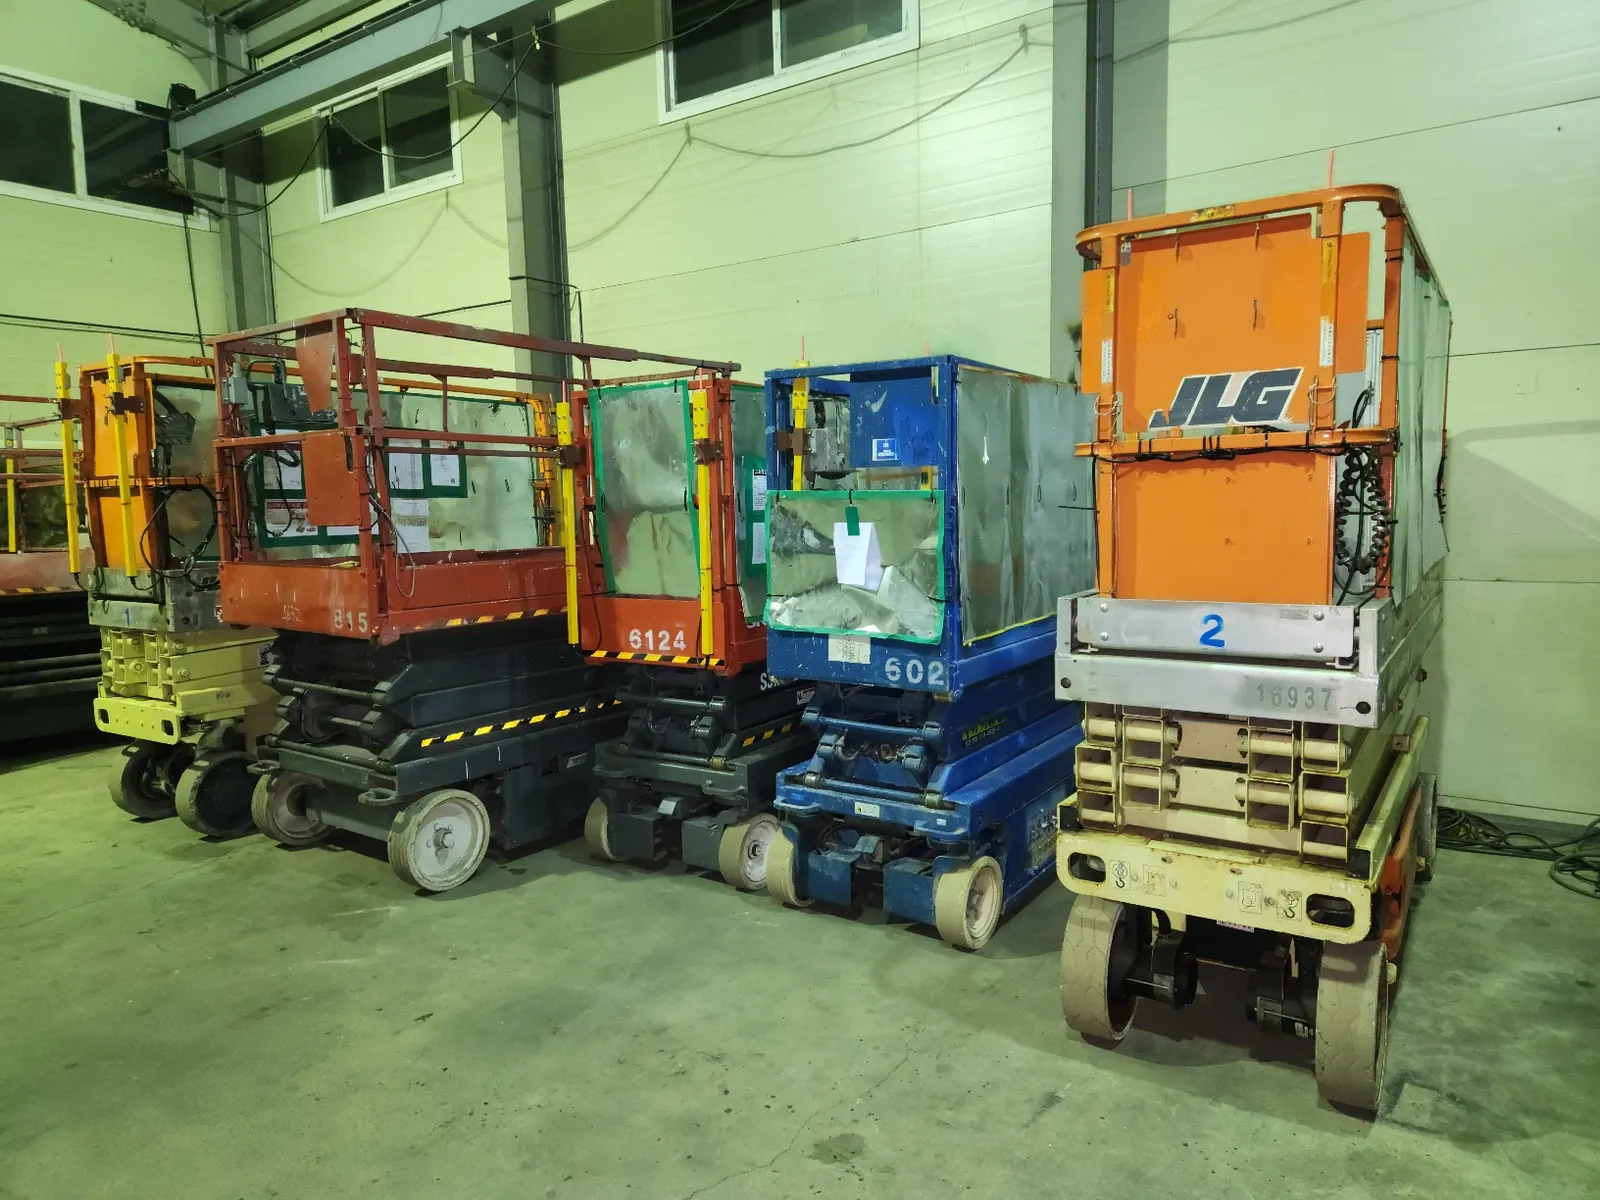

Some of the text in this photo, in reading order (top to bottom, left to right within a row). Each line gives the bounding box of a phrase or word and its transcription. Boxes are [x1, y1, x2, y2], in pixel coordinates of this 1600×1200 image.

[1148, 367, 1303, 429] JLG
[124, 608, 130, 626] 1
[333, 608, 368, 633] 815
[1199, 613, 1225, 648] 2
[629, 629, 686, 650] 6124
[885, 657, 944, 686] 602
[1257, 683, 1333, 711] 16937
